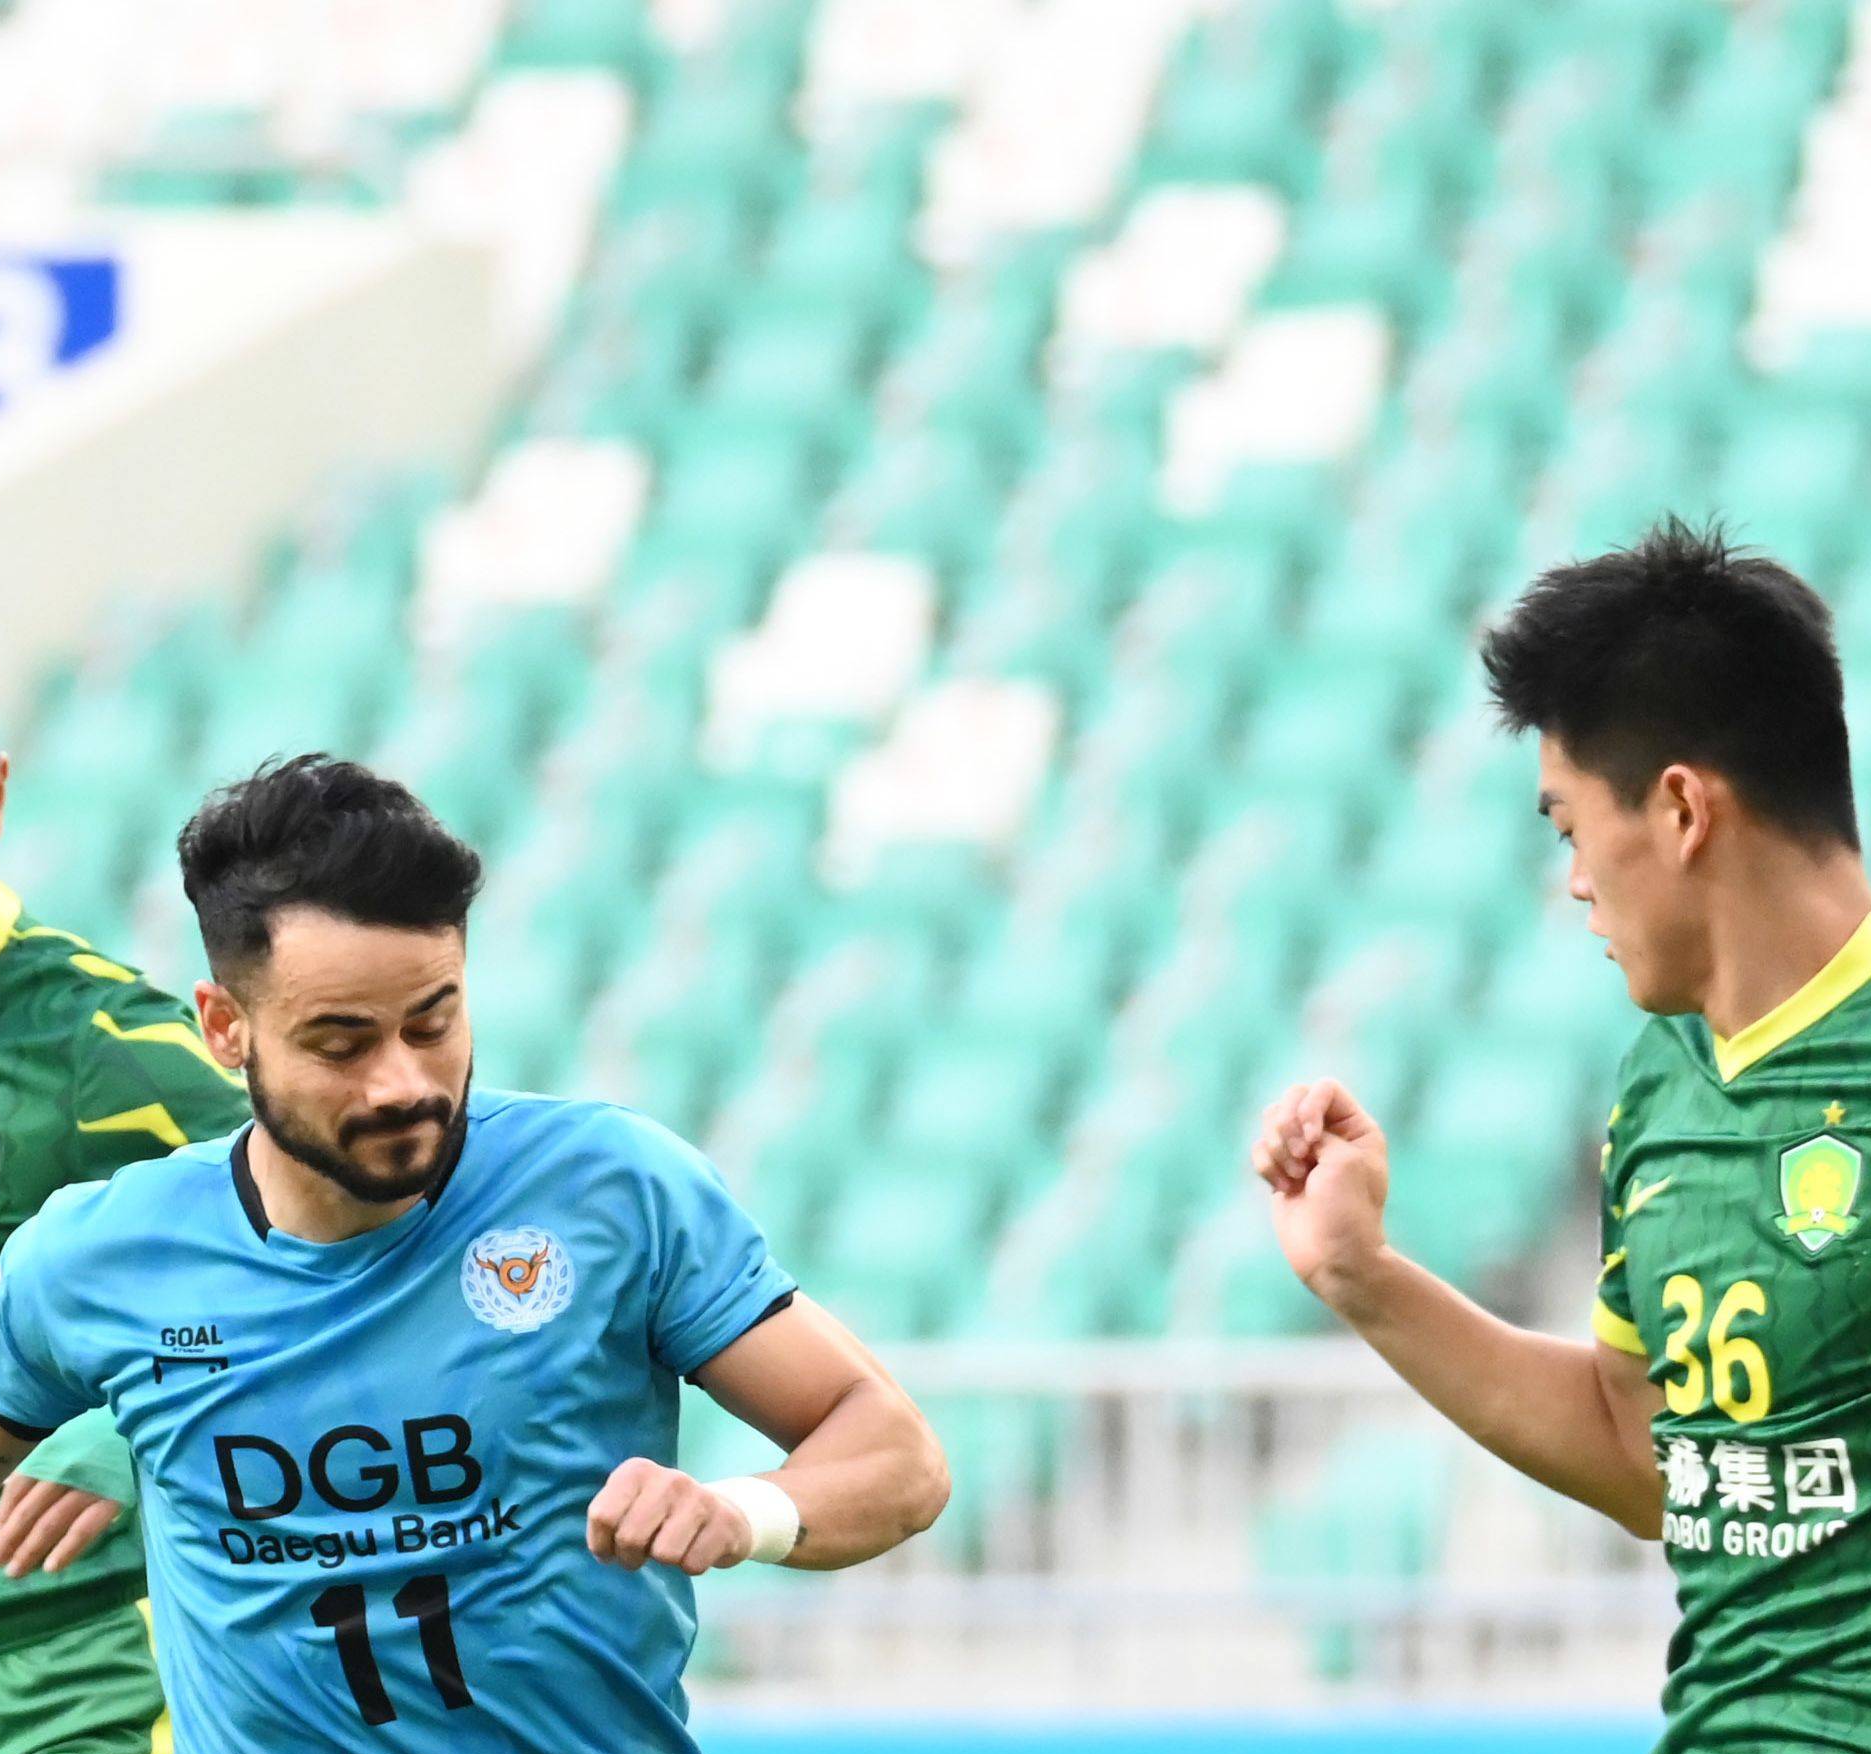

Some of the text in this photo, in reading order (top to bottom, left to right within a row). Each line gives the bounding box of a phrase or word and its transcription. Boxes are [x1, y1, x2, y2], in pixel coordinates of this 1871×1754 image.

[161, 1324, 224, 1347] GOAL
[1662, 1274, 1771, 1422] 36
[213, 1413, 484, 1521] DGB
[219, 1498, 521, 1568] Daegu Bank
[310, 1574, 474, 1726] 11
